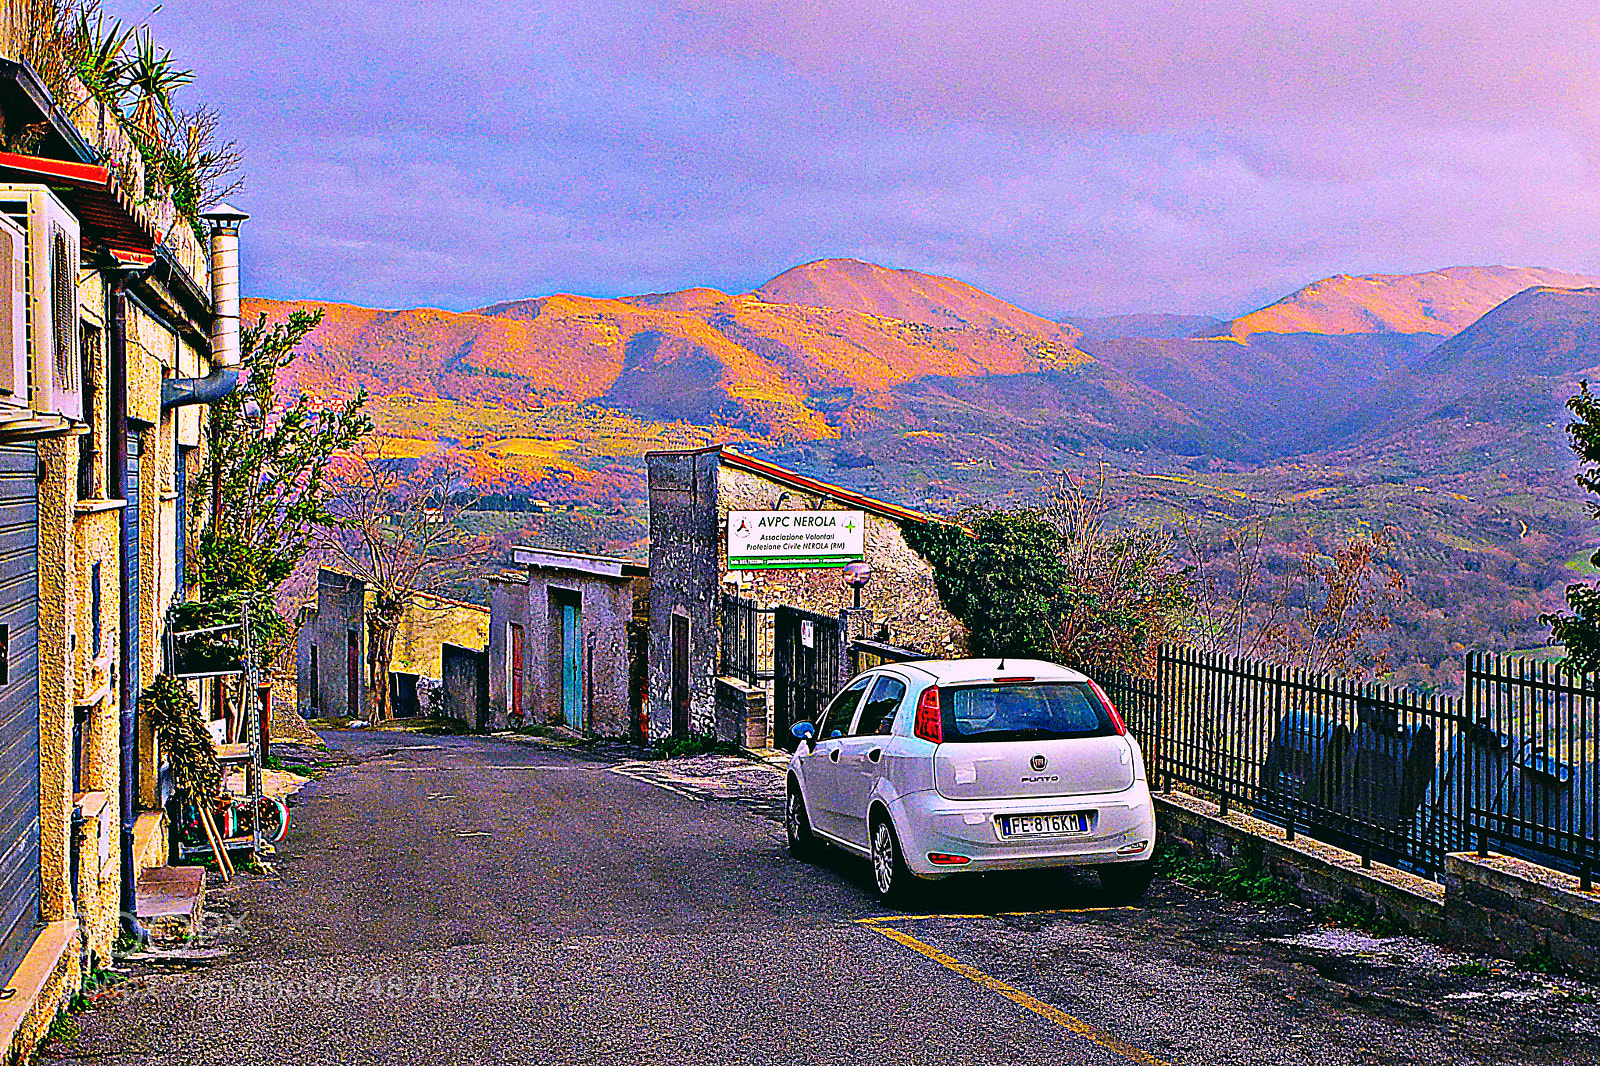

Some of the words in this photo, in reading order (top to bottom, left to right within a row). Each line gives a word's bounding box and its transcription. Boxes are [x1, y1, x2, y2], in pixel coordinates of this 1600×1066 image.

[758, 516, 790, 528] AVPC
[793, 516, 837, 527] NEROLA
[760, 533, 804, 541] Associazione
[805, 532, 835, 541] Volontari
[746, 543, 782, 551] Protezione
[802, 542, 829, 550] NEROLA
[830, 541, 846, 551] (RM)
[1021, 775, 1059, 783] PUNTO
